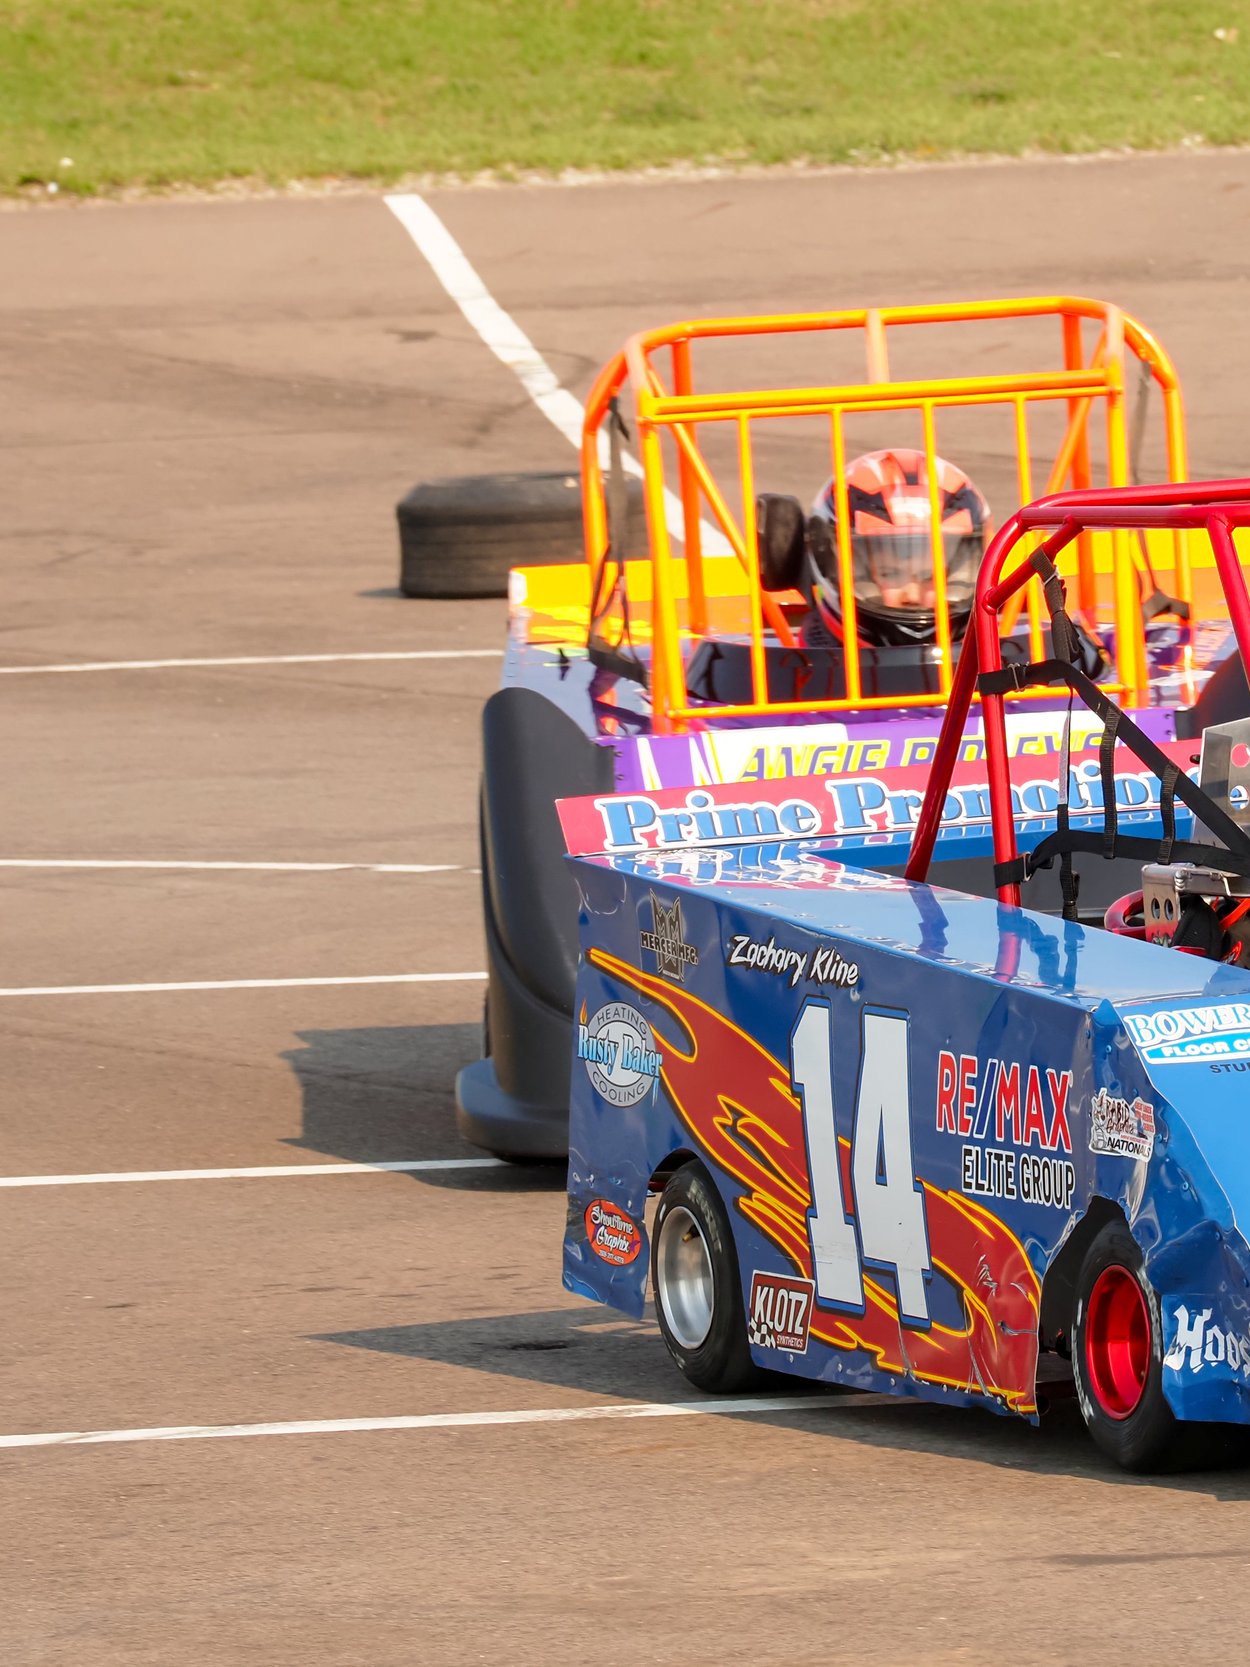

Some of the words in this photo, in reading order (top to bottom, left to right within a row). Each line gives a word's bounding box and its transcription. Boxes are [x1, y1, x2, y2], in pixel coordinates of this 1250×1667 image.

[596, 790, 821, 849] Prime
[828, 763, 1200, 830] Promotio
[640, 931, 678, 958] MERCER
[729, 935, 808, 987] Zachary
[809, 947, 859, 986] Kline
[596, 1006, 648, 1035] HEATING
[577, 1024, 619, 1076] Rusty
[621, 1034, 662, 1077] Baker
[1161, 1041, 1229, 1057] FLOOR
[592, 1071, 645, 1103] COOLING
[937, 1051, 1073, 1153] RE/MAX
[791, 995, 932, 1331] 14
[1107, 1137, 1151, 1158] NATIONALS
[962, 1144, 1017, 1199] ELITE
[1020, 1152, 1076, 1209] GROUP
[755, 1285, 808, 1335] KLOTZ
